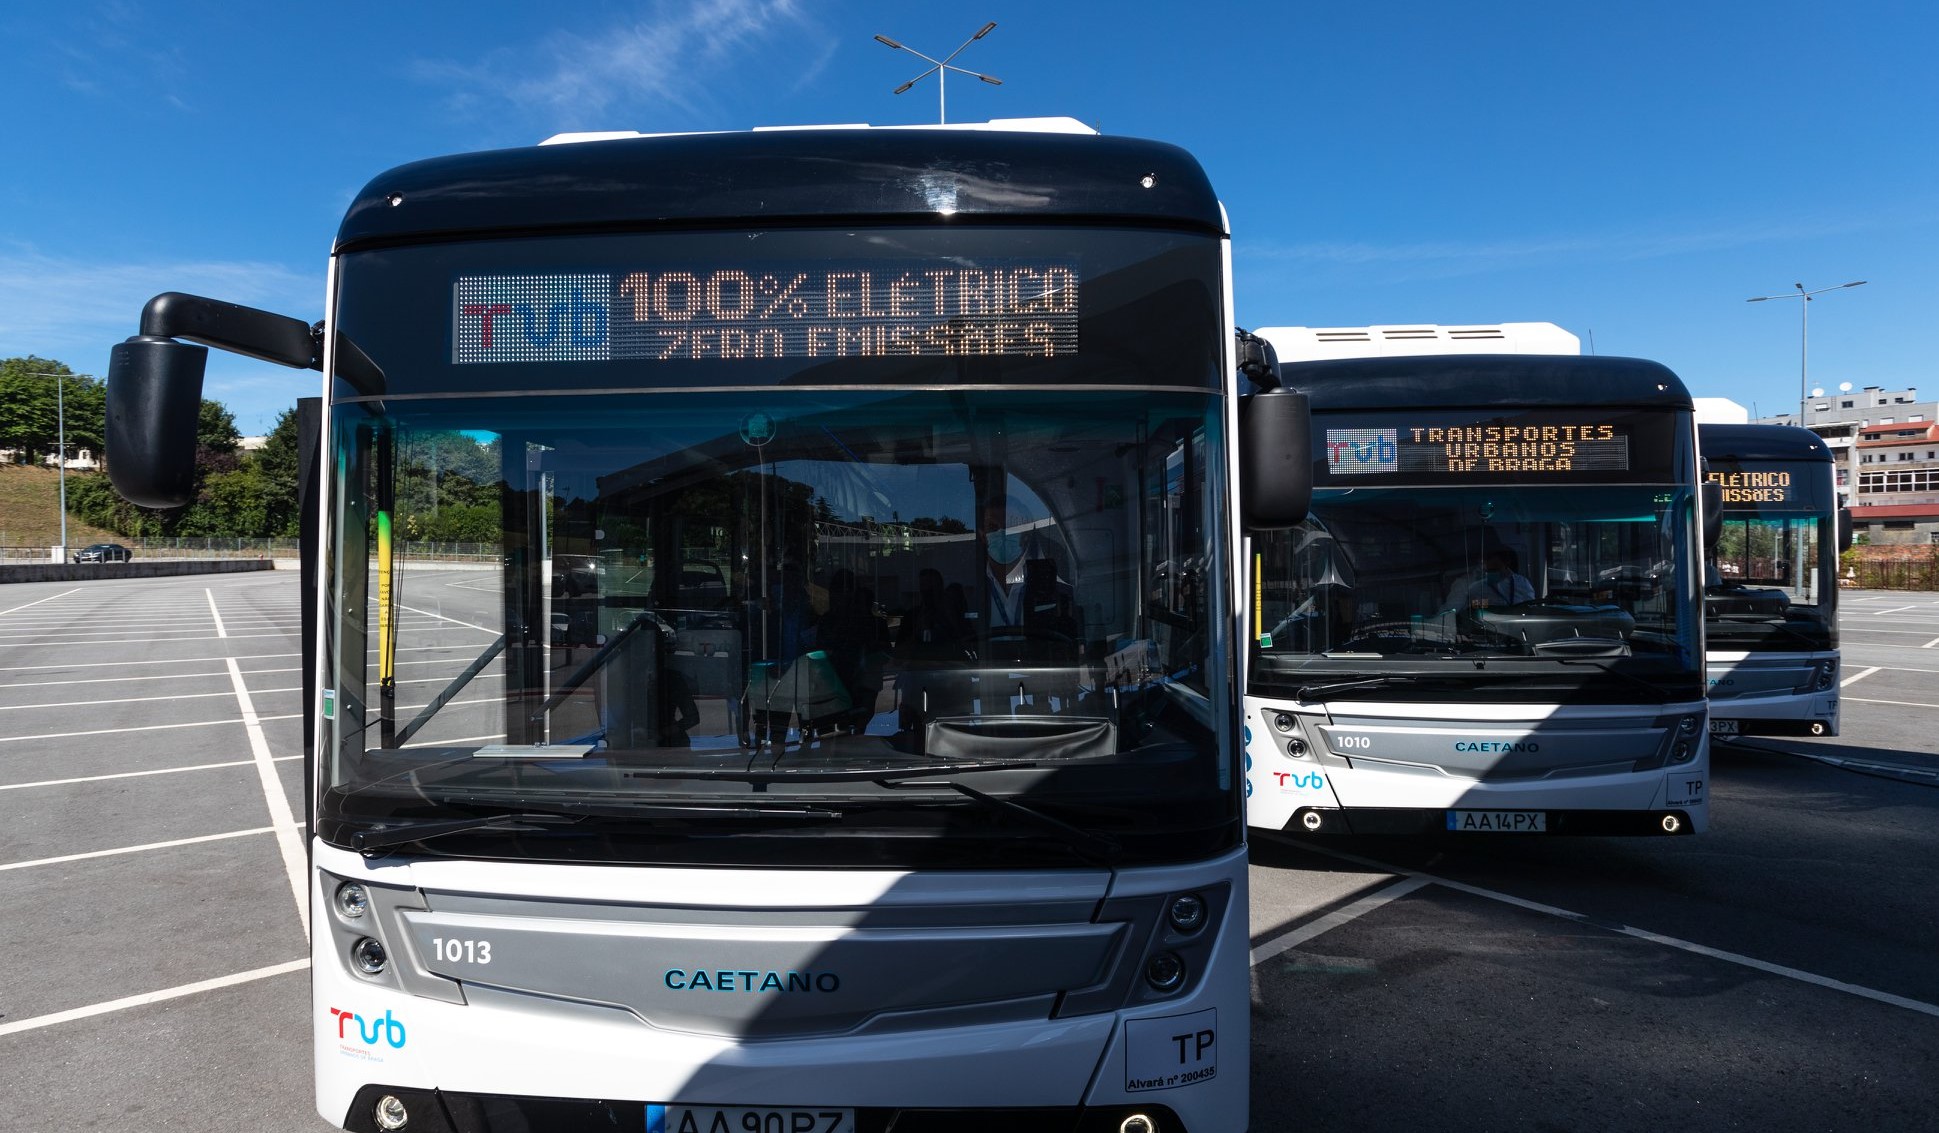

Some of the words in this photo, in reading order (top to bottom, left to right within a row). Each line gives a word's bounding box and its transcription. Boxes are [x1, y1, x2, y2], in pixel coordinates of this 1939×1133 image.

[620, 270, 807, 321] 100%
[827, 267, 1074, 317] ELÉTRICO
[1410, 425, 1615, 443] TRANSPORTES
[1445, 441, 1577, 458] URBANOS
[1448, 458, 1477, 472] DE
[1488, 457, 1573, 472] BRAGA
[1721, 488, 1785, 502] ISSÕES
[1709, 679, 1736, 687] ANO
[1710, 721, 1735, 733] 3PX
[1337, 736, 1371, 749] 1010
[1455, 742, 1540, 754] CAETANO
[1686, 780, 1703, 796] TP
[1463, 812, 1539, 831] AA14PX
[433, 937, 492, 965] 1013
[664, 968, 841, 994] CAETANO
[1171, 1029, 1215, 1065] TP
[1127, 1077, 1165, 1090] Alvará
[1180, 1066, 1215, 1083] 200435
[676, 1109, 844, 1133] AA90PZ
